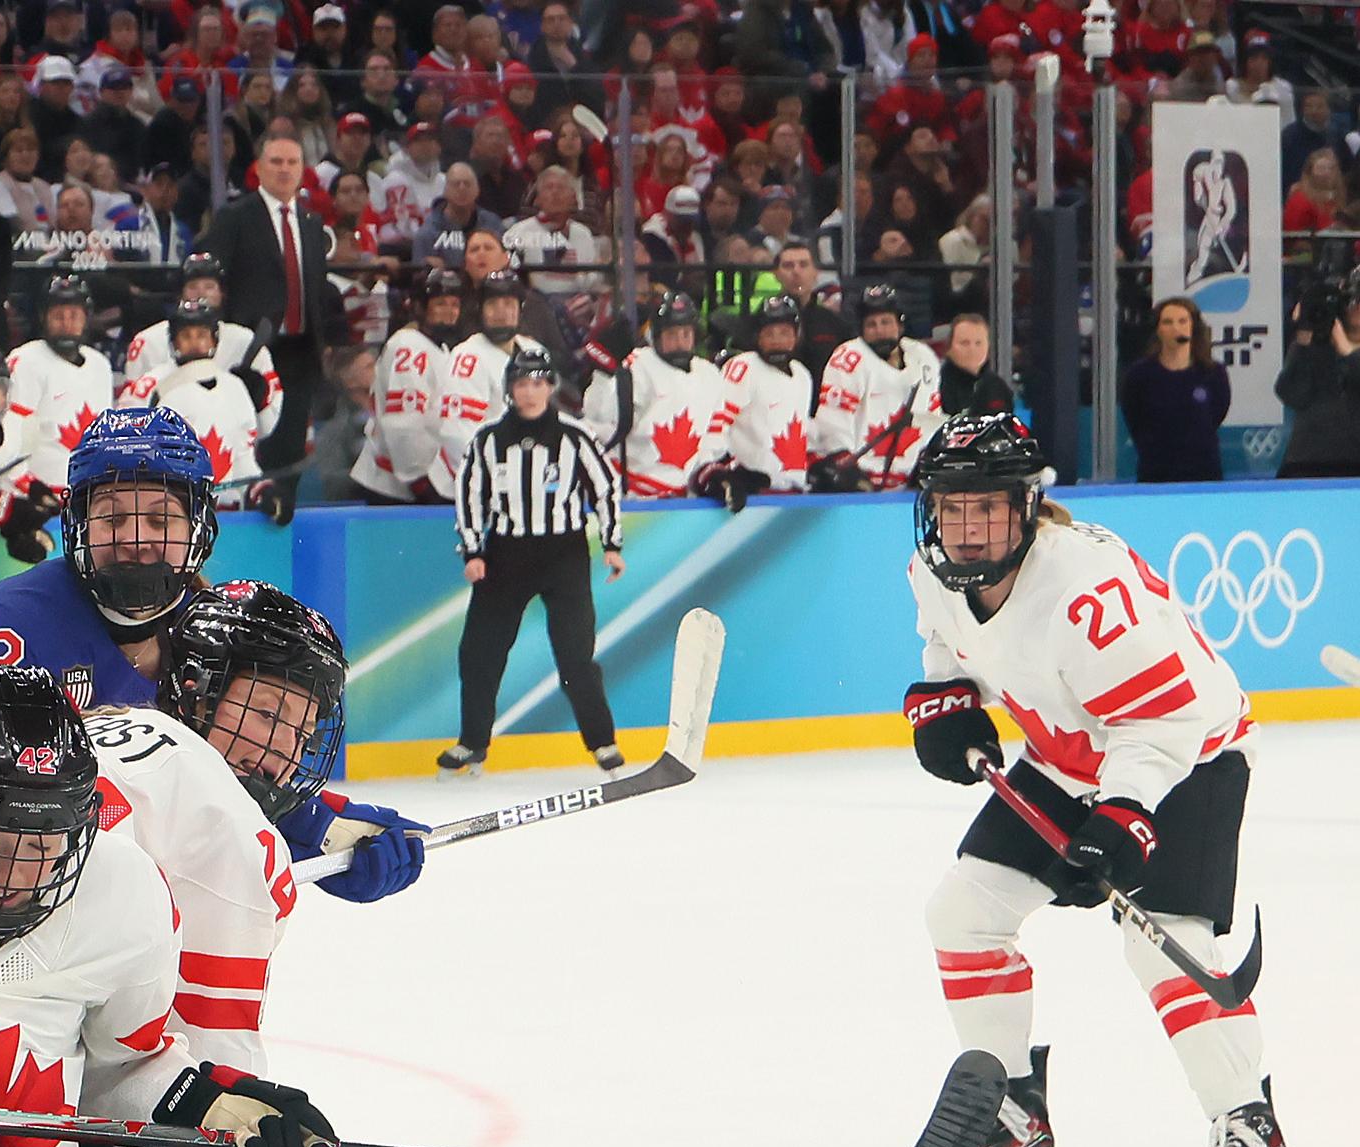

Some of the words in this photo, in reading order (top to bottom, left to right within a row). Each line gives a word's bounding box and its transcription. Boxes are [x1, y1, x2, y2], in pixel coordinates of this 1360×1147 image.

[12, 230, 86, 250] MILANO
[434, 230, 465, 249] MIL
[70, 252, 108, 271] 2026
[393, 347, 428, 375] 24
[450, 351, 479, 379] 19
[723, 360, 750, 385] 10
[830, 348, 863, 374] 29
[921, 364, 932, 385] C
[1067, 576, 1139, 651] 27
[66, 670, 89, 684] USA
[907, 694, 973, 726] CCM
[16, 746, 58, 775] 42
[497, 785, 605, 830] BAUER
[167, 1072, 197, 1114] BAUER
